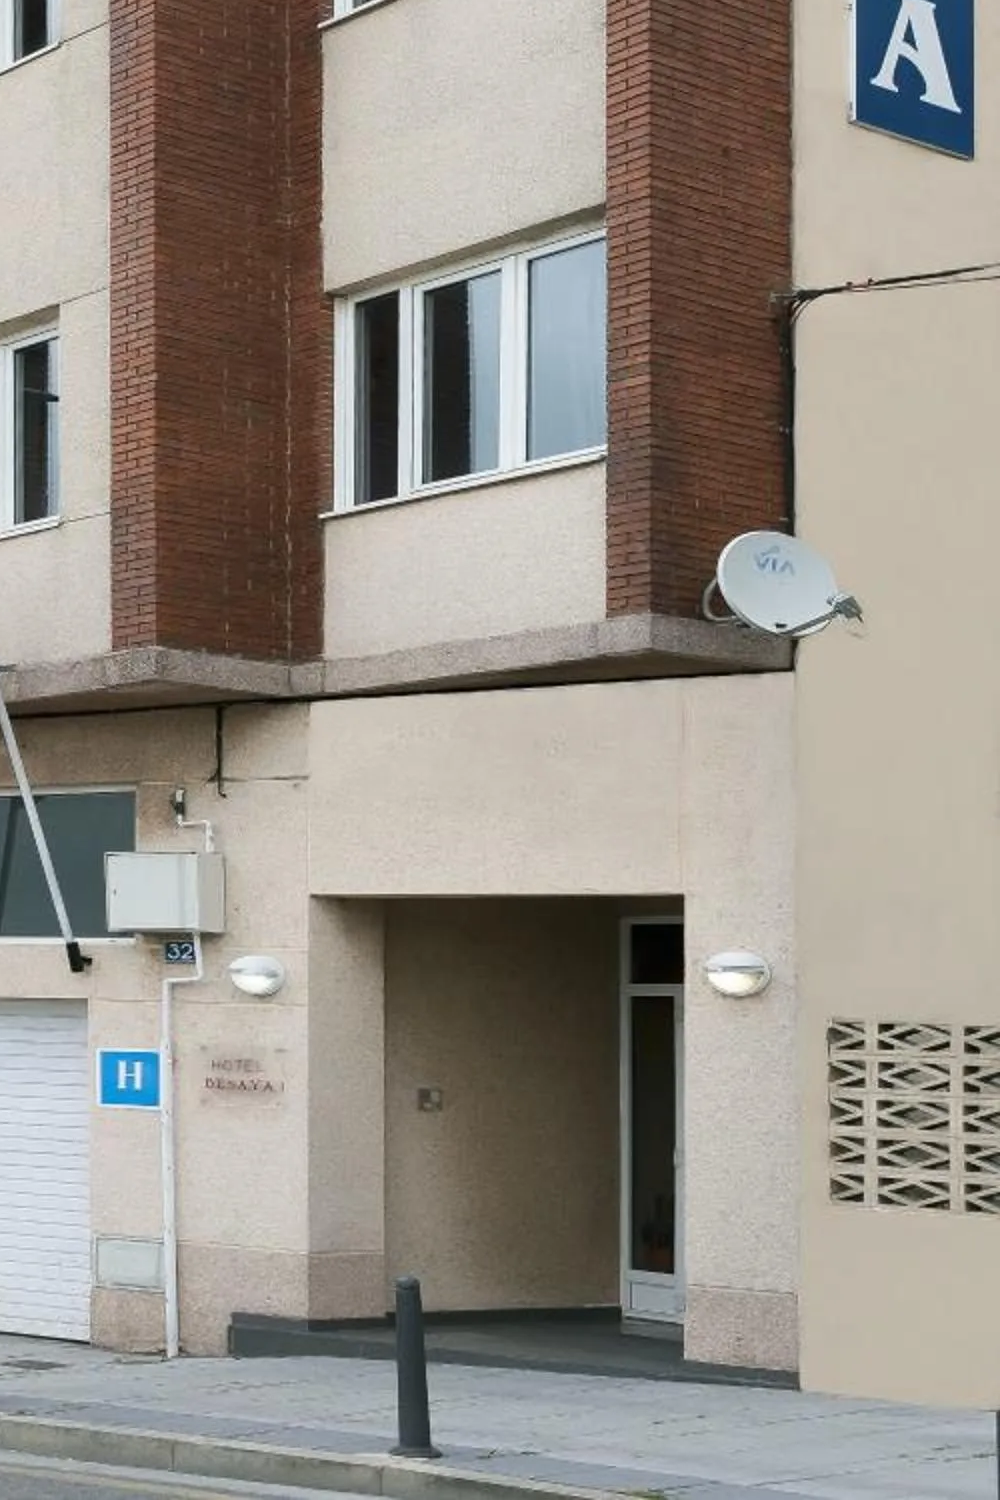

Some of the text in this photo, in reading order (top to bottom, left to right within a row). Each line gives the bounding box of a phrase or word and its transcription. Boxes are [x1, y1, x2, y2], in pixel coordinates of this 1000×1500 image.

[167, 943, 194, 960] 32
[211, 1059, 265, 1073] HOTEL
[117, 1060, 142, 1090] H
